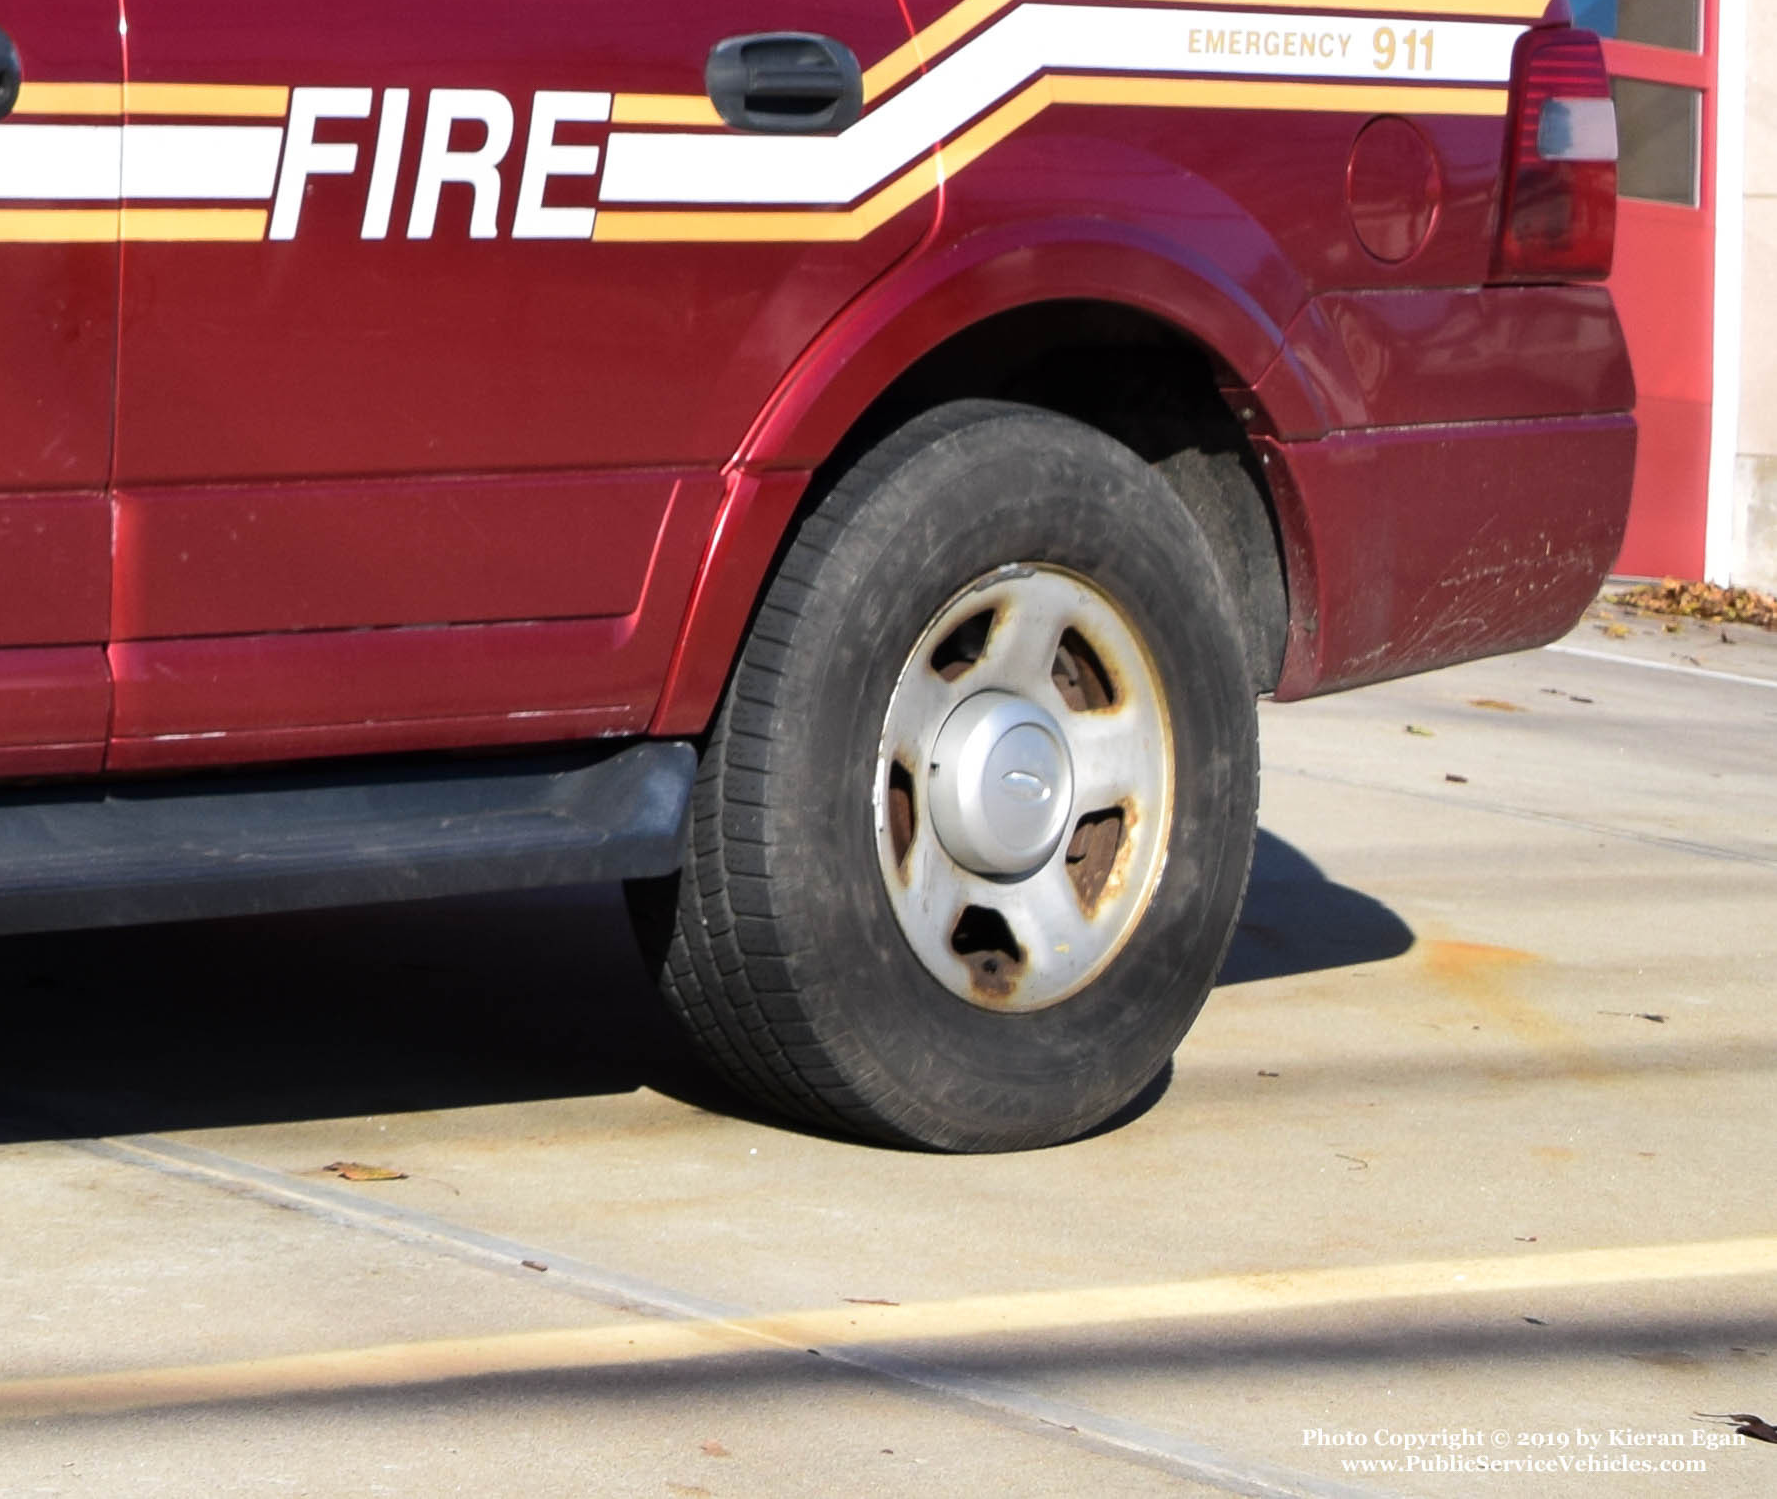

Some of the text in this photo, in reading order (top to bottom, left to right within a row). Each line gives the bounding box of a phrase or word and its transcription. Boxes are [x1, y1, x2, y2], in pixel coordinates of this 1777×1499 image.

[1188, 26, 1434, 70] EMERGENCY 911
[268, 87, 612, 241] FIRE
